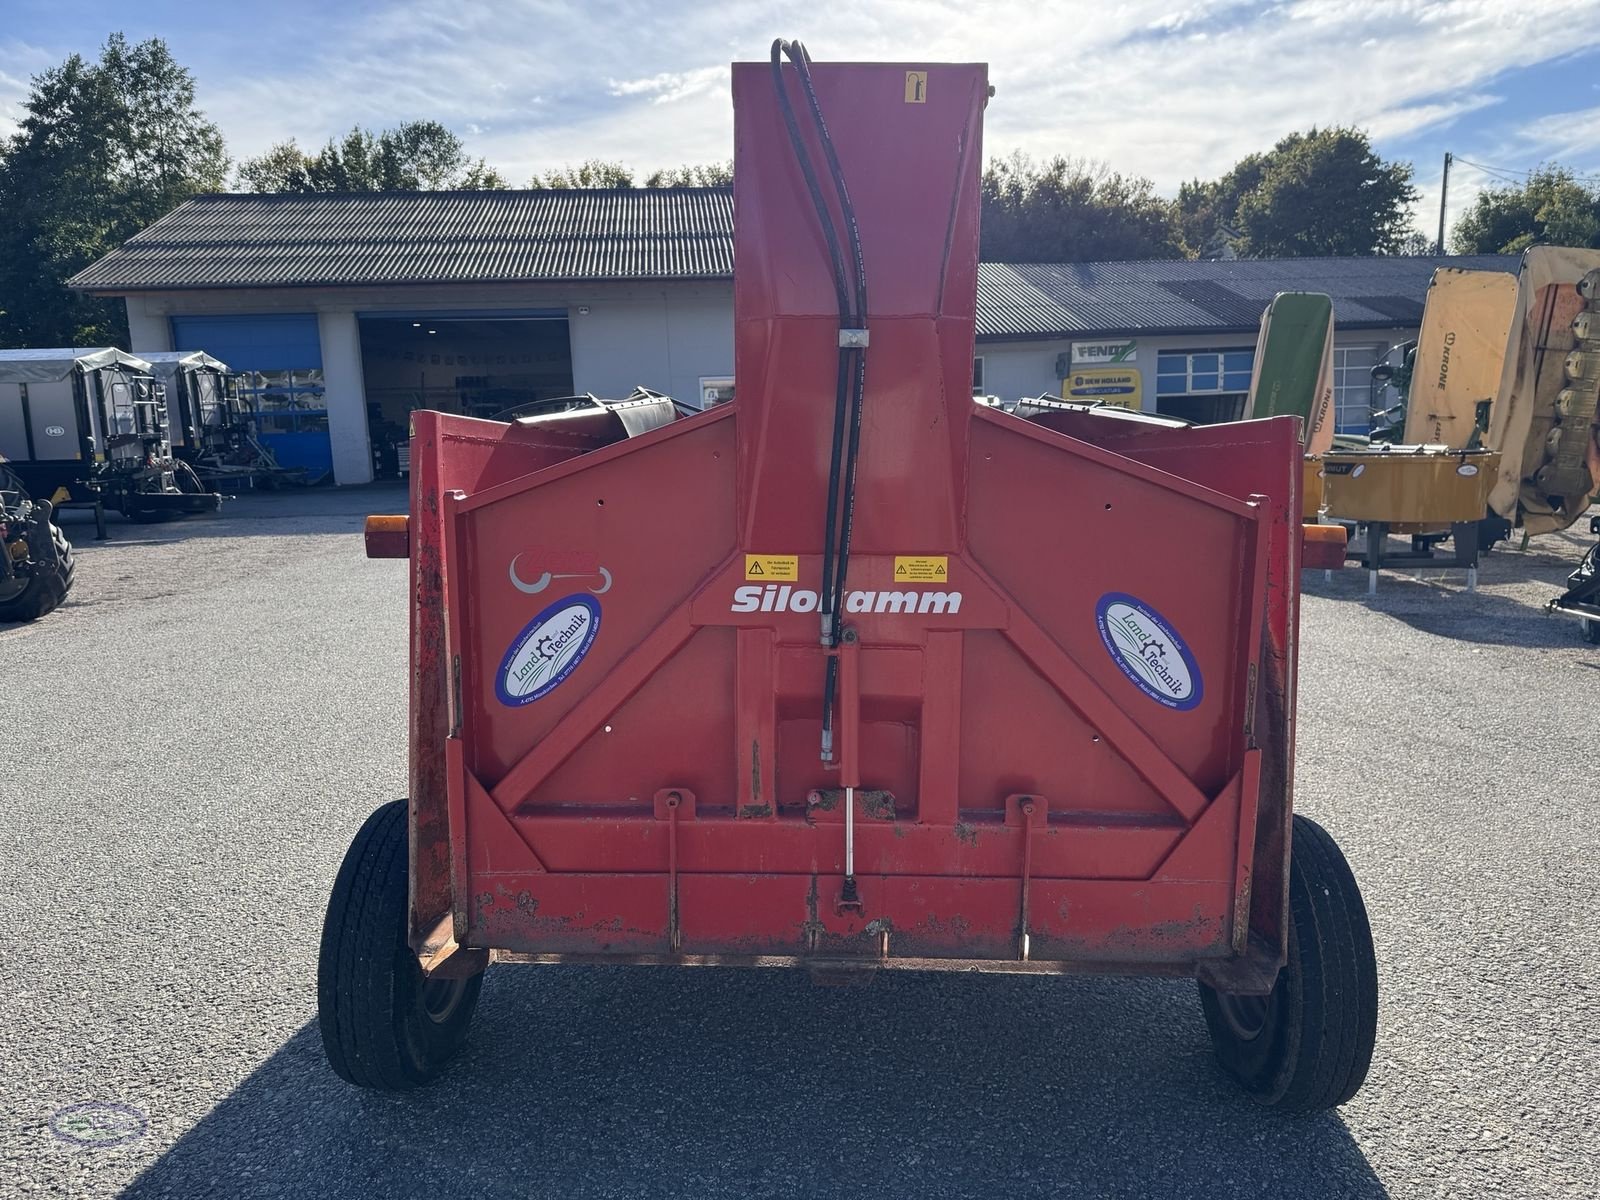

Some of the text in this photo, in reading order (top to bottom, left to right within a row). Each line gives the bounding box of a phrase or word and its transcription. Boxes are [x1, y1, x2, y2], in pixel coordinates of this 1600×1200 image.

[1077, 344, 1129, 357] FENDT
[1437, 345, 1451, 391] KRONE
[1317, 388, 1333, 422] KRONE
[547, 613, 588, 654] Technik
[1122, 612, 1152, 642] Land
[512, 651, 541, 682] Land
[1145, 650, 1183, 695] Technik
